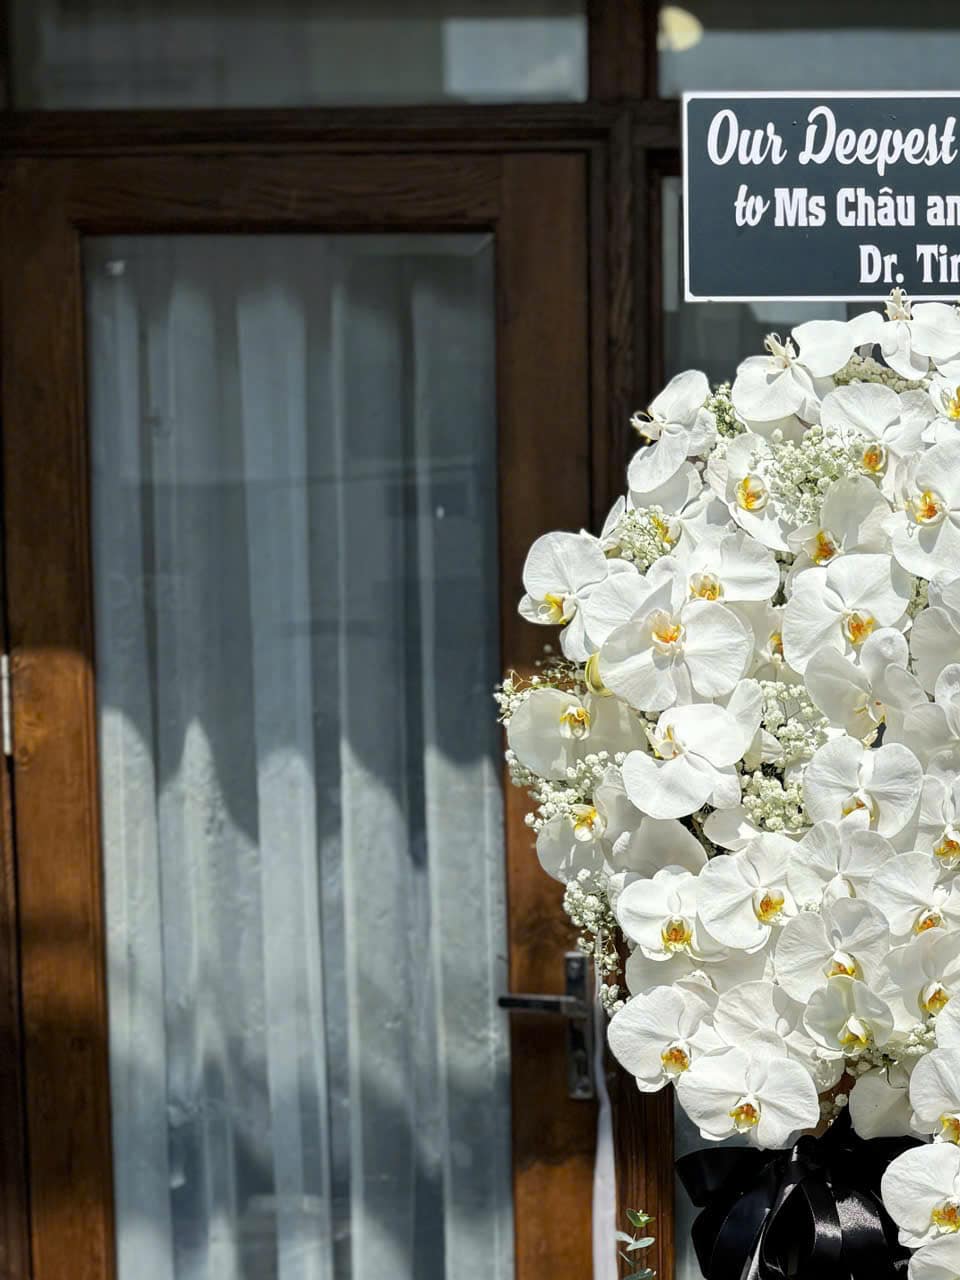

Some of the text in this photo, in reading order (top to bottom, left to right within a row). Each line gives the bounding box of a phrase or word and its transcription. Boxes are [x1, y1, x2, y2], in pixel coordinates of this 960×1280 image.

[706, 109, 788, 166] Our
[799, 105, 959, 177] Deepest
[733, 183, 771, 227] to
[774, 187, 827, 227] Ms
[836, 186, 917, 227] Châu
[858, 244, 905, 284] Dr.
